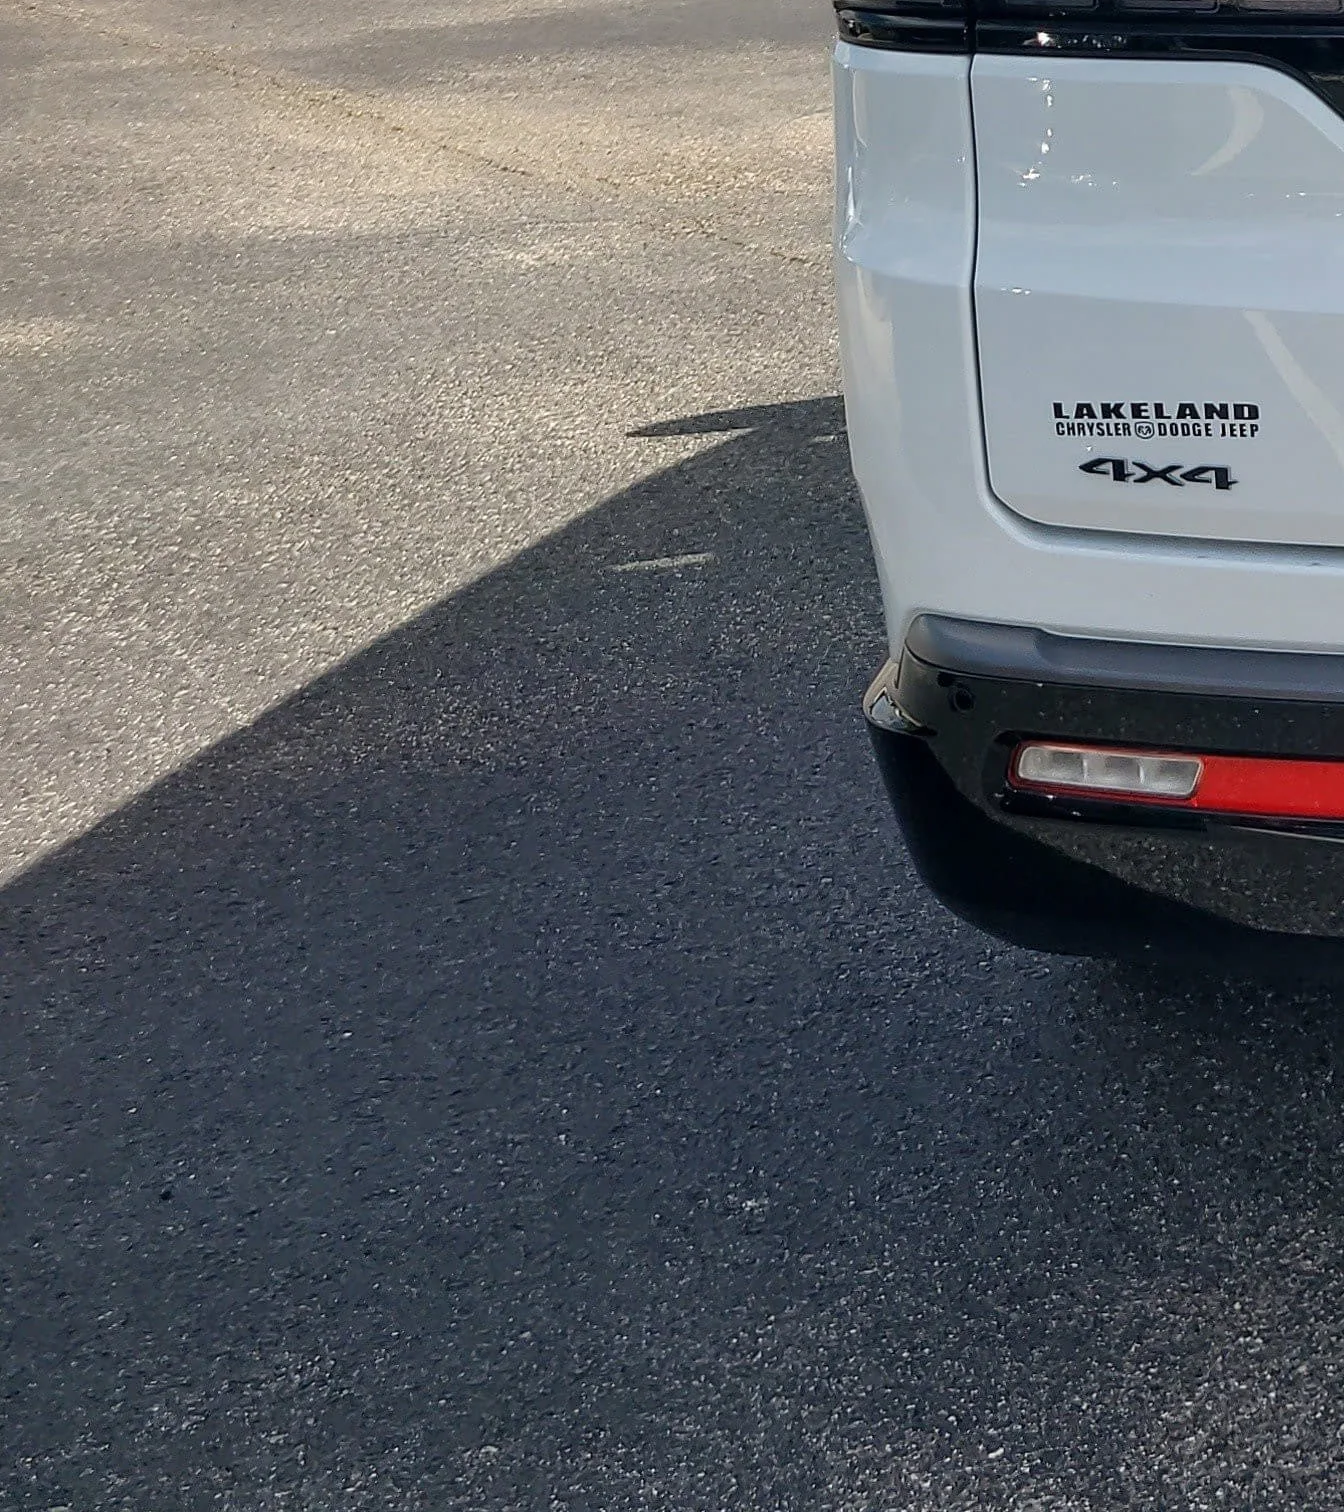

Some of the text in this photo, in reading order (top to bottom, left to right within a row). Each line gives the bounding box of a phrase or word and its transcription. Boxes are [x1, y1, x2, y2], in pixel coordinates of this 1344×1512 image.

[1052, 402, 1260, 420] LAKELAND
[1056, 421, 1259, 438] CHRYSLER DODGE JEEP
